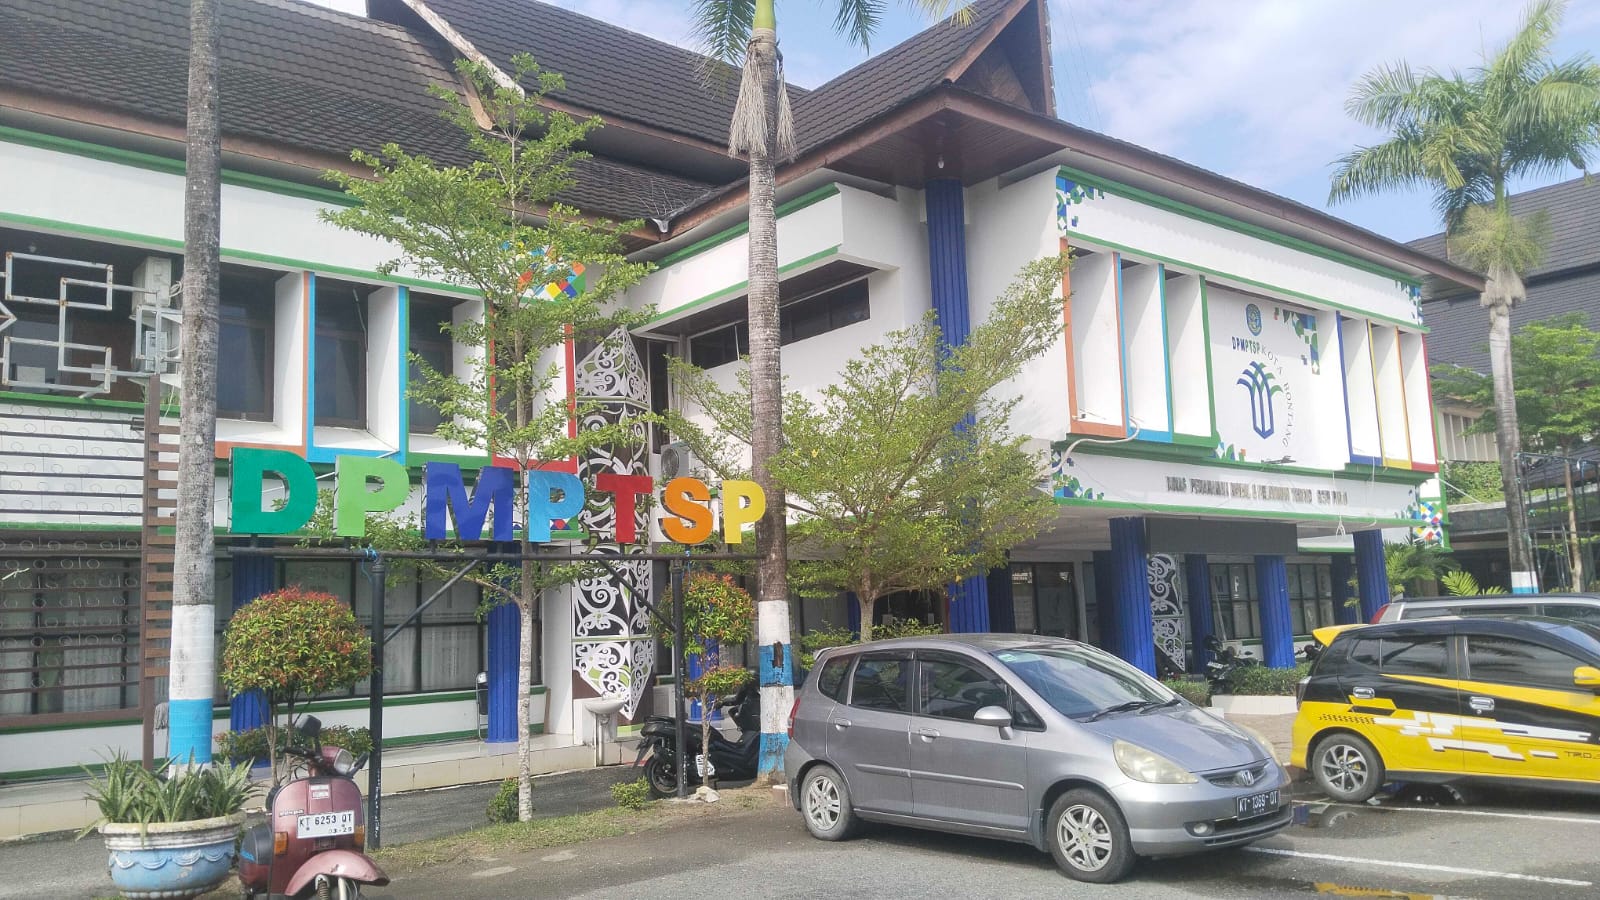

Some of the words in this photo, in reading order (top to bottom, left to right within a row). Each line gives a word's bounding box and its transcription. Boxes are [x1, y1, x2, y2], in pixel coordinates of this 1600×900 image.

[1232, 336, 1260, 355] DPMPTSP
[229, 447, 766, 545] DPMPTSP
[1239, 798, 1248, 813] KT
[299, 817, 310, 828] KT
[314, 815, 336, 825] 6253
